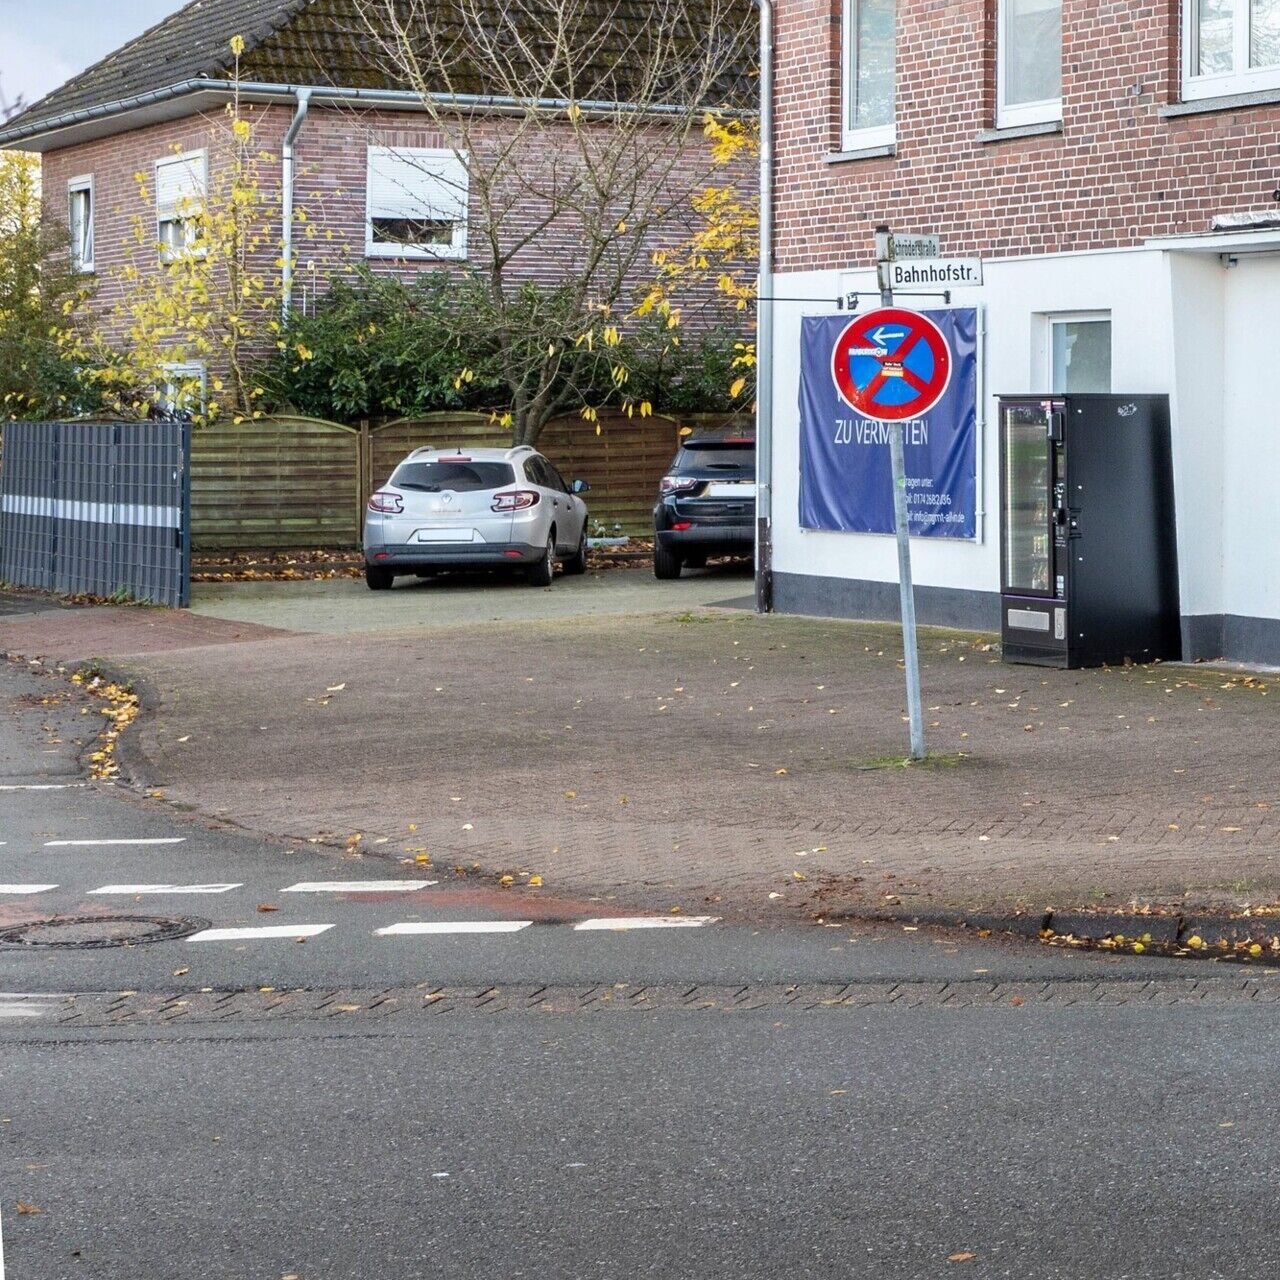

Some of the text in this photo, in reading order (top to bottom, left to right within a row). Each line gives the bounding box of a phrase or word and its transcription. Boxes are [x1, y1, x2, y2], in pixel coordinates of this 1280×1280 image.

[889, 239, 936, 257] chröderstraße
[895, 264, 978, 283] Bahnhofstr.
[834, 420, 928, 445] ZU VERMTEN
